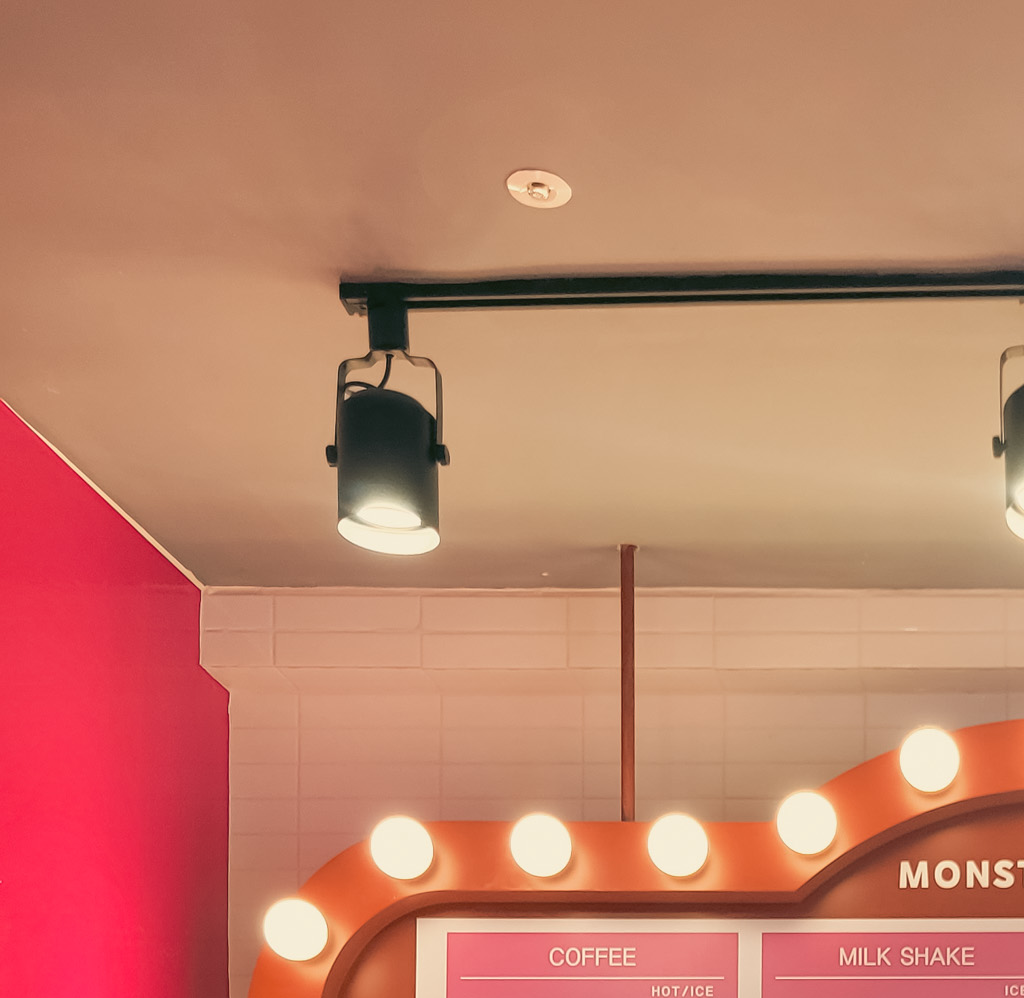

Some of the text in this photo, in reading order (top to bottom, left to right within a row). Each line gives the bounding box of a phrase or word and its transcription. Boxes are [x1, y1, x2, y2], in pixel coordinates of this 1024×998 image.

[550, 947, 636, 966] COFFEE
[840, 947, 974, 966] MILK SHAKE
[652, 986, 713, 997] HOT/ICE
